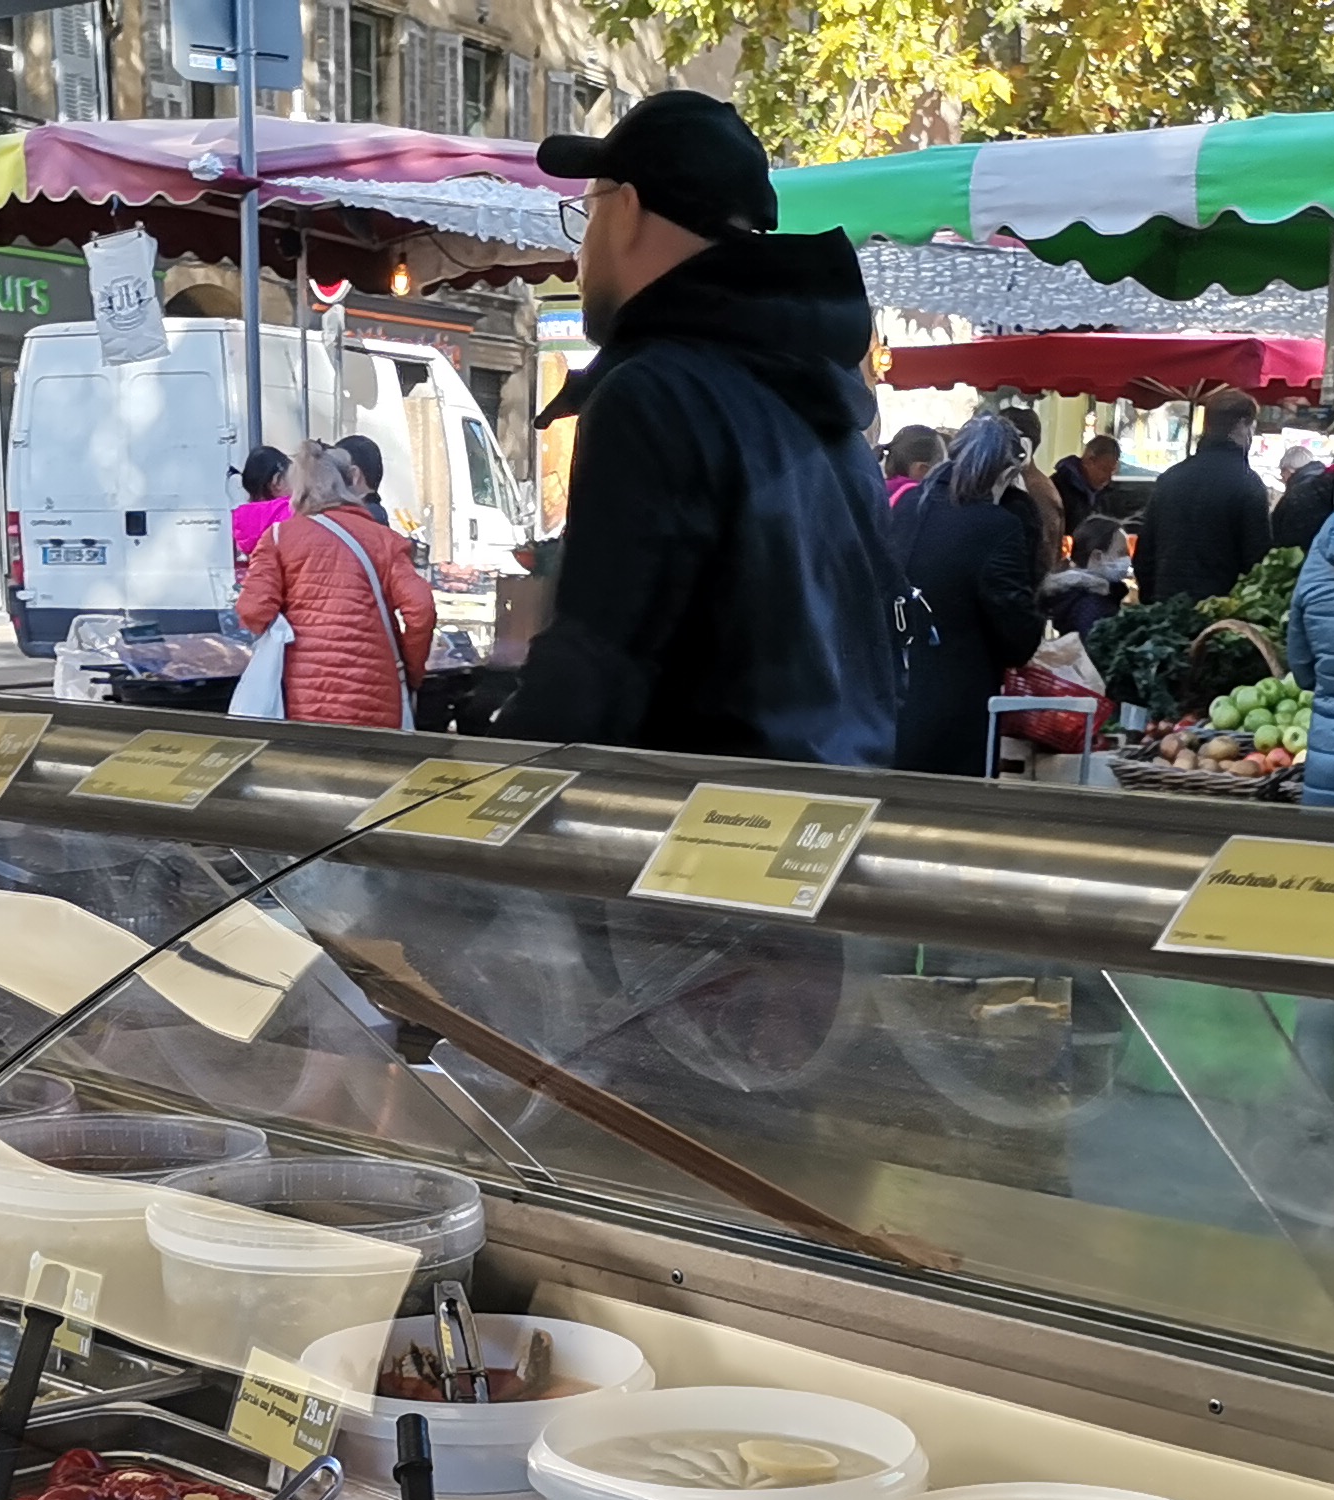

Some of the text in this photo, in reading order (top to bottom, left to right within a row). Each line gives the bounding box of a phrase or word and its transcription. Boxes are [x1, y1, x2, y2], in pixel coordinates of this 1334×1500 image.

[836, 822, 854, 843] €
[1207, 869, 1277, 889] Anchois
[1278, 873, 1294, 891] à
